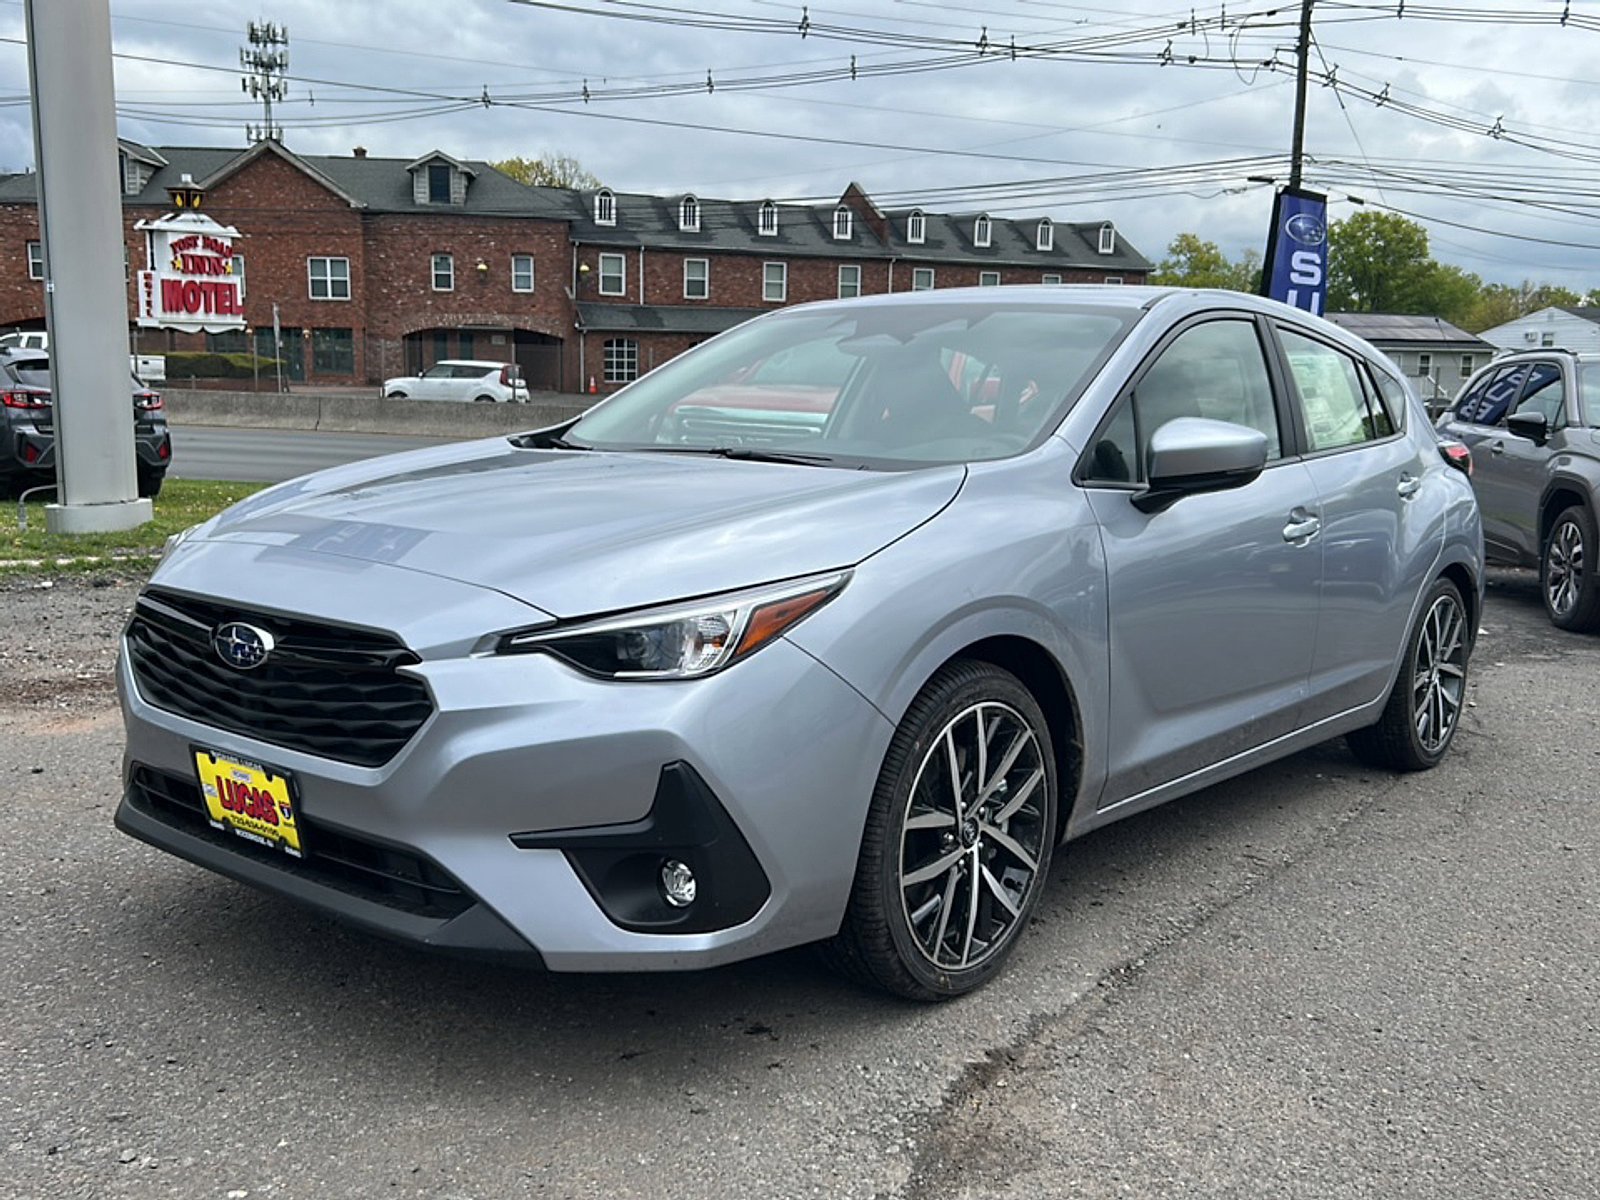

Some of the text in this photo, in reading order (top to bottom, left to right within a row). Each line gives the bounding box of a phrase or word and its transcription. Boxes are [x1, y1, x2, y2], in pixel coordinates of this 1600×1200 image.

[181, 254, 226, 275] INN
[160, 279, 246, 315] MOTEL
[215, 775, 279, 826] LUCAS
